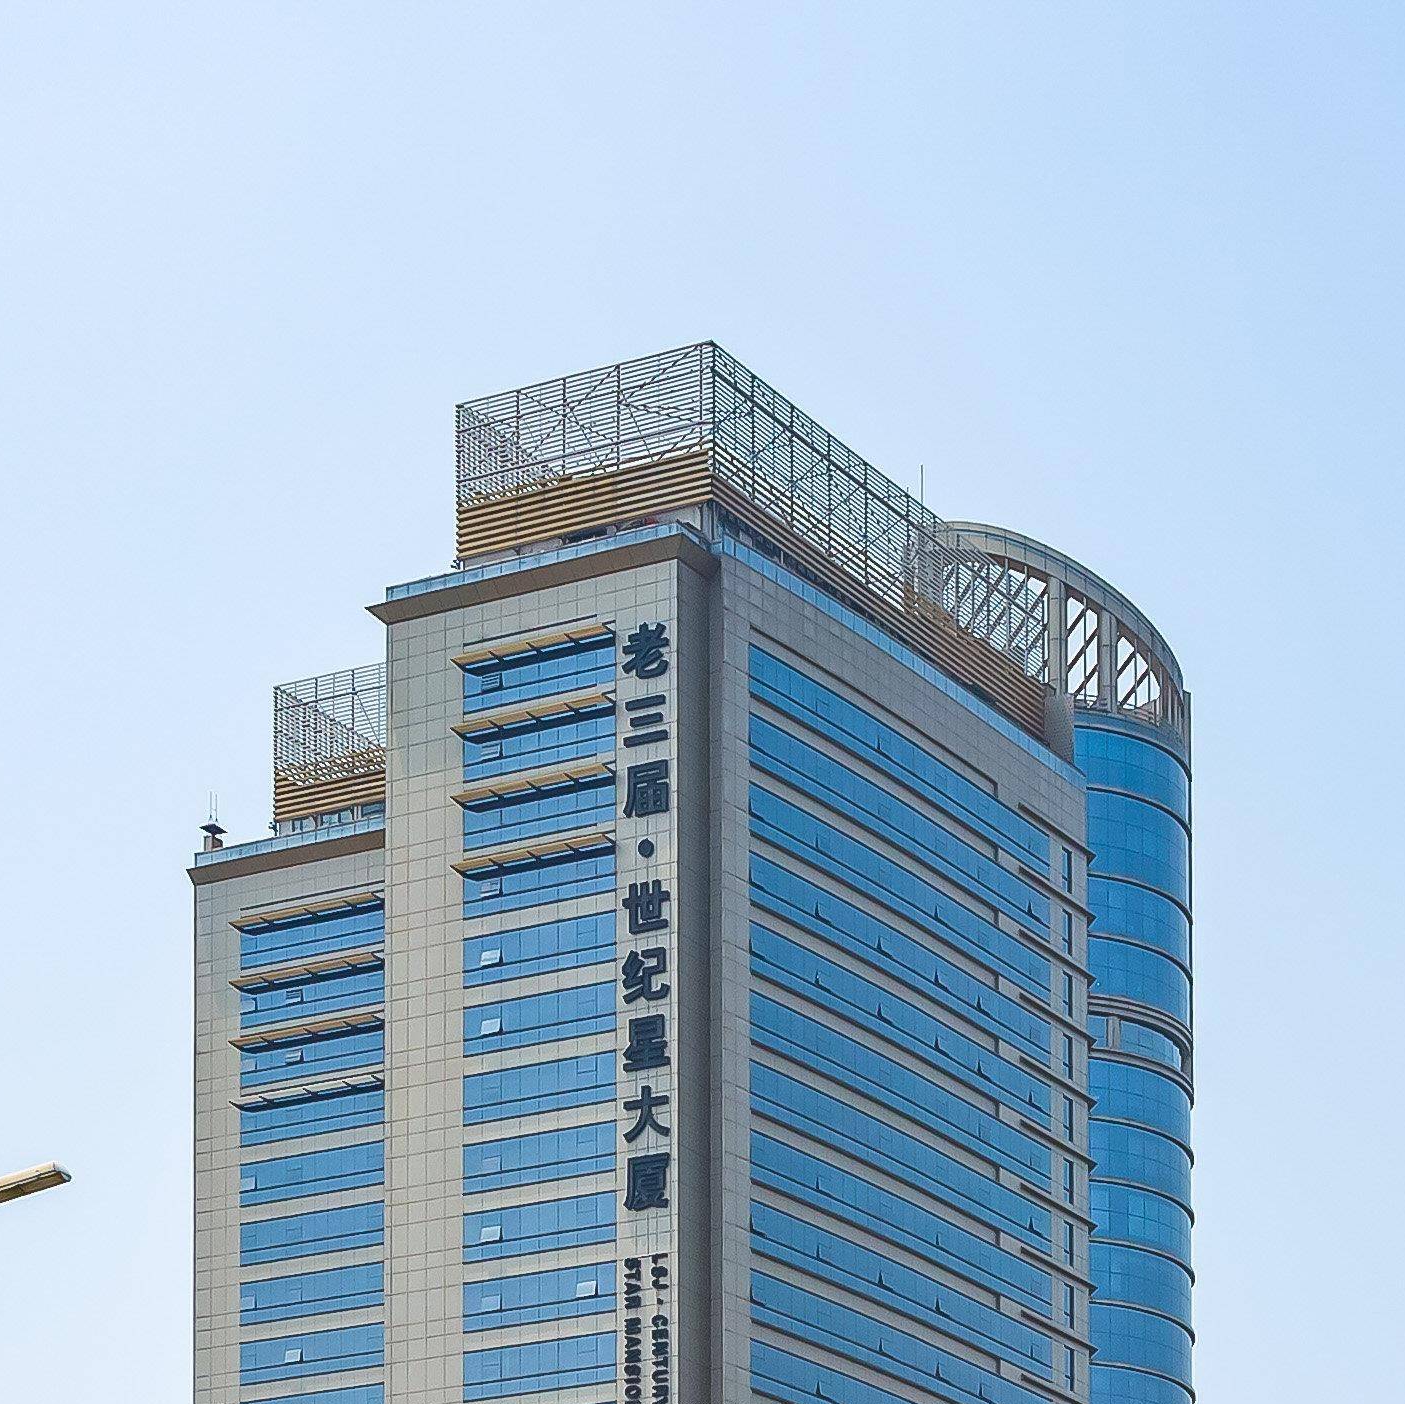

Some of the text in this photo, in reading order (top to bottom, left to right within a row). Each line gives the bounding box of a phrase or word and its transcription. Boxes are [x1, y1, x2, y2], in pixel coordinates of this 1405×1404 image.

[621, 621, 672, 1212] 老三届·世纪星大厦
[624, 1257, 642, 1310] STAR
